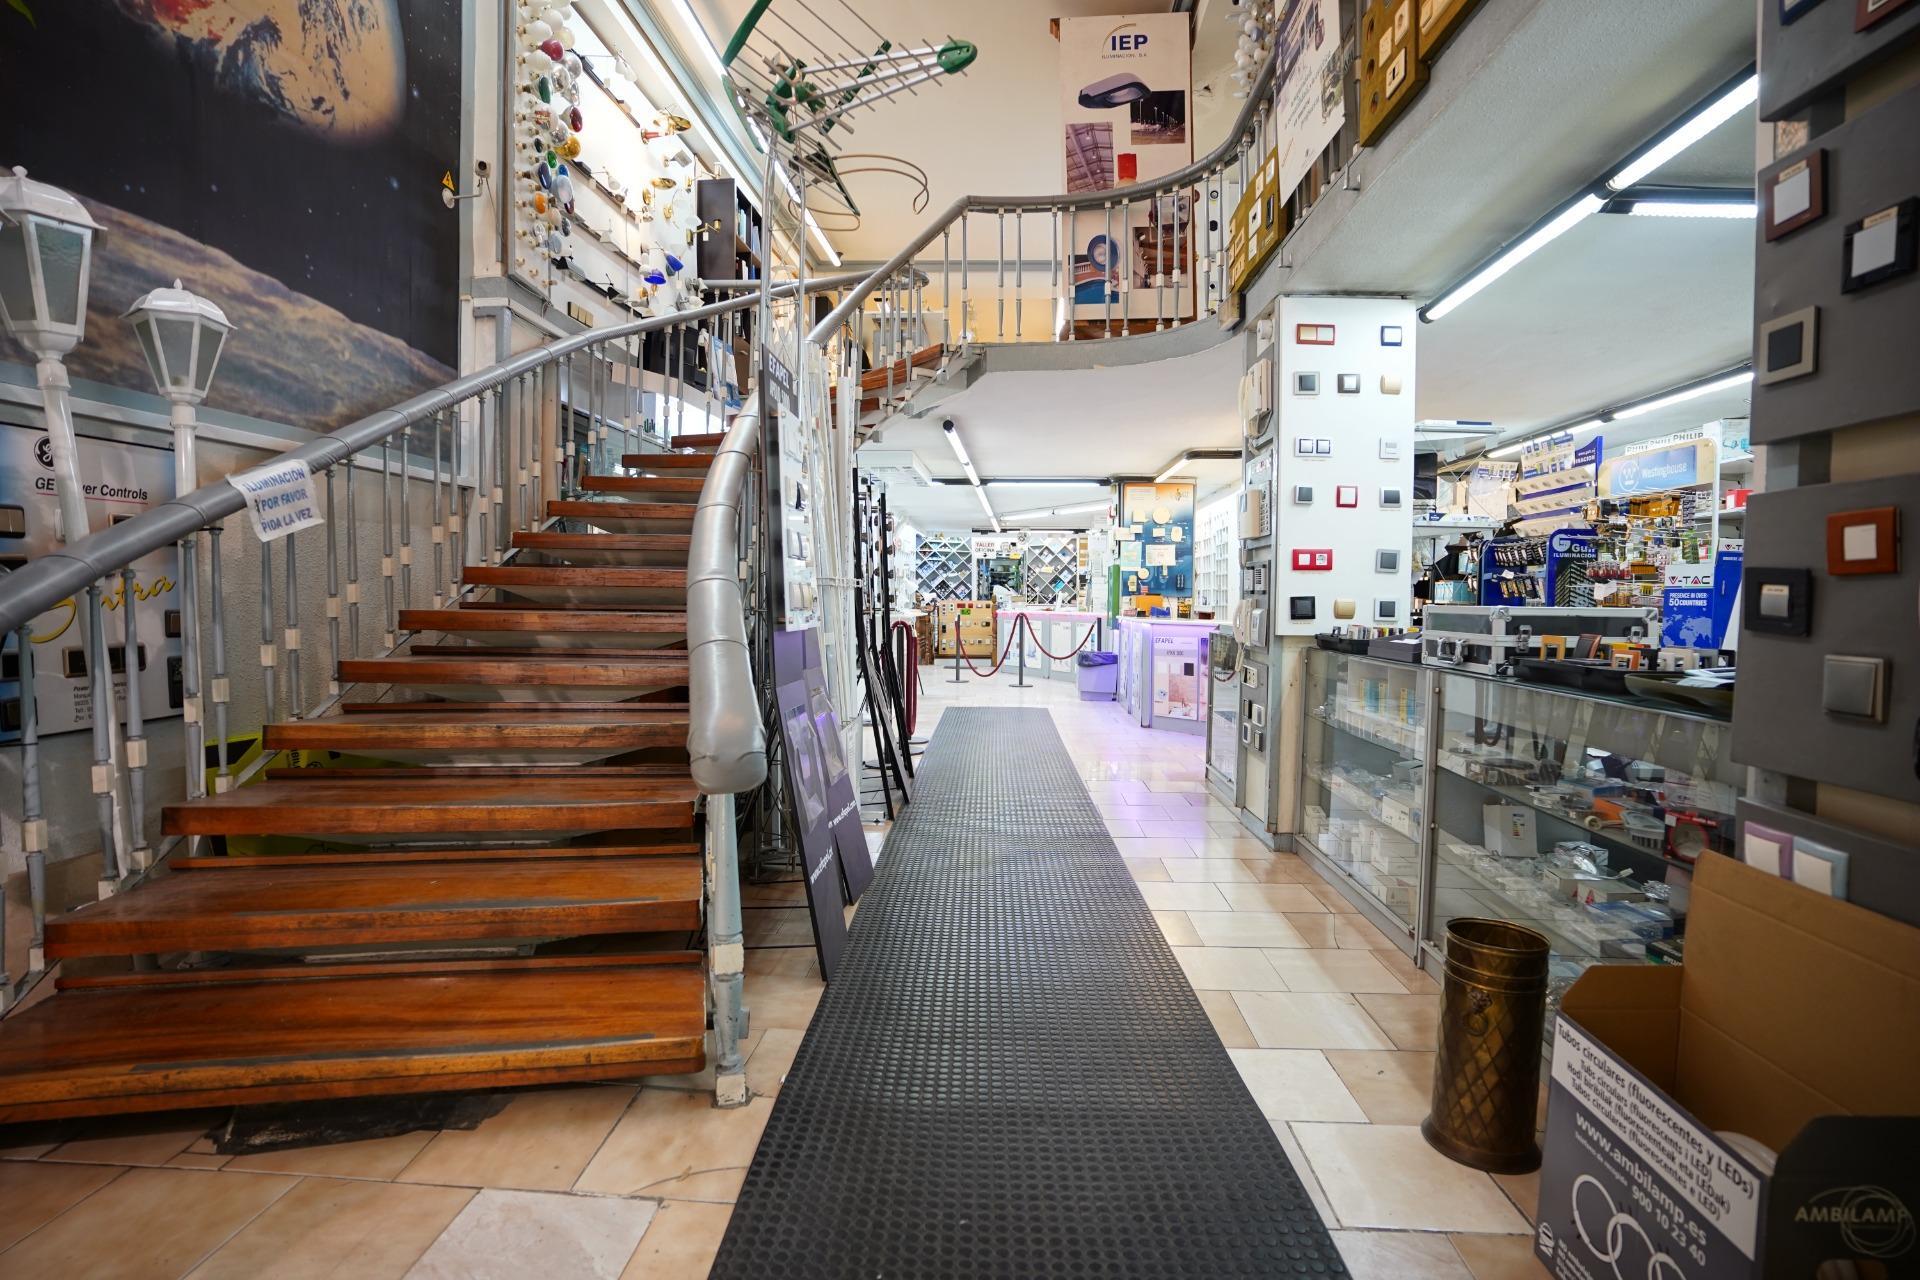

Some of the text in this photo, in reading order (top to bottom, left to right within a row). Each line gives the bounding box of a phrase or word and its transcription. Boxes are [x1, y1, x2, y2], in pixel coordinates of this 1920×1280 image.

[1111, 35, 1148, 50] IEP
[769, 353, 790, 389] EFAPEL
[1673, 432, 1704, 441] PHILIP
[242, 468, 306, 493] ILUMINACION
[1641, 462, 1688, 479] Westinghouse
[35, 477, 55, 491] GE
[100, 484, 148, 500] Controls
[261, 489, 308, 511] POR FAVOR
[261, 508, 313, 533] PIDA LA VEZ
[1669, 576, 1711, 585] V-TAC
[1559, 1023, 1753, 1200] Tubos circulares (fluorescentes y LEDs)
[1580, 1059, 1595, 1080] Tubs
[1597, 1076, 1628, 1107] circulars
[1630, 1101, 1682, 1155] (fluorescents
[1691, 1154, 1712, 1182] LED)
[1567, 1061, 1730, 1214] Hodi biribilak (fluoreszenteak eta LEDak)
[1571, 1078, 1591, 1102] Tubos
[1592, 1098, 1627, 1134] circulares
[1629, 1129, 1687, 1189] (fluorescentes
[1698, 1191, 1720, 1221] LED)
[1576, 1112, 1707, 1245] www.ambilamp.es
[1632, 1185, 1706, 1266] 900 10 23 40
[1793, 1206, 1910, 1223] AMBILAMP
